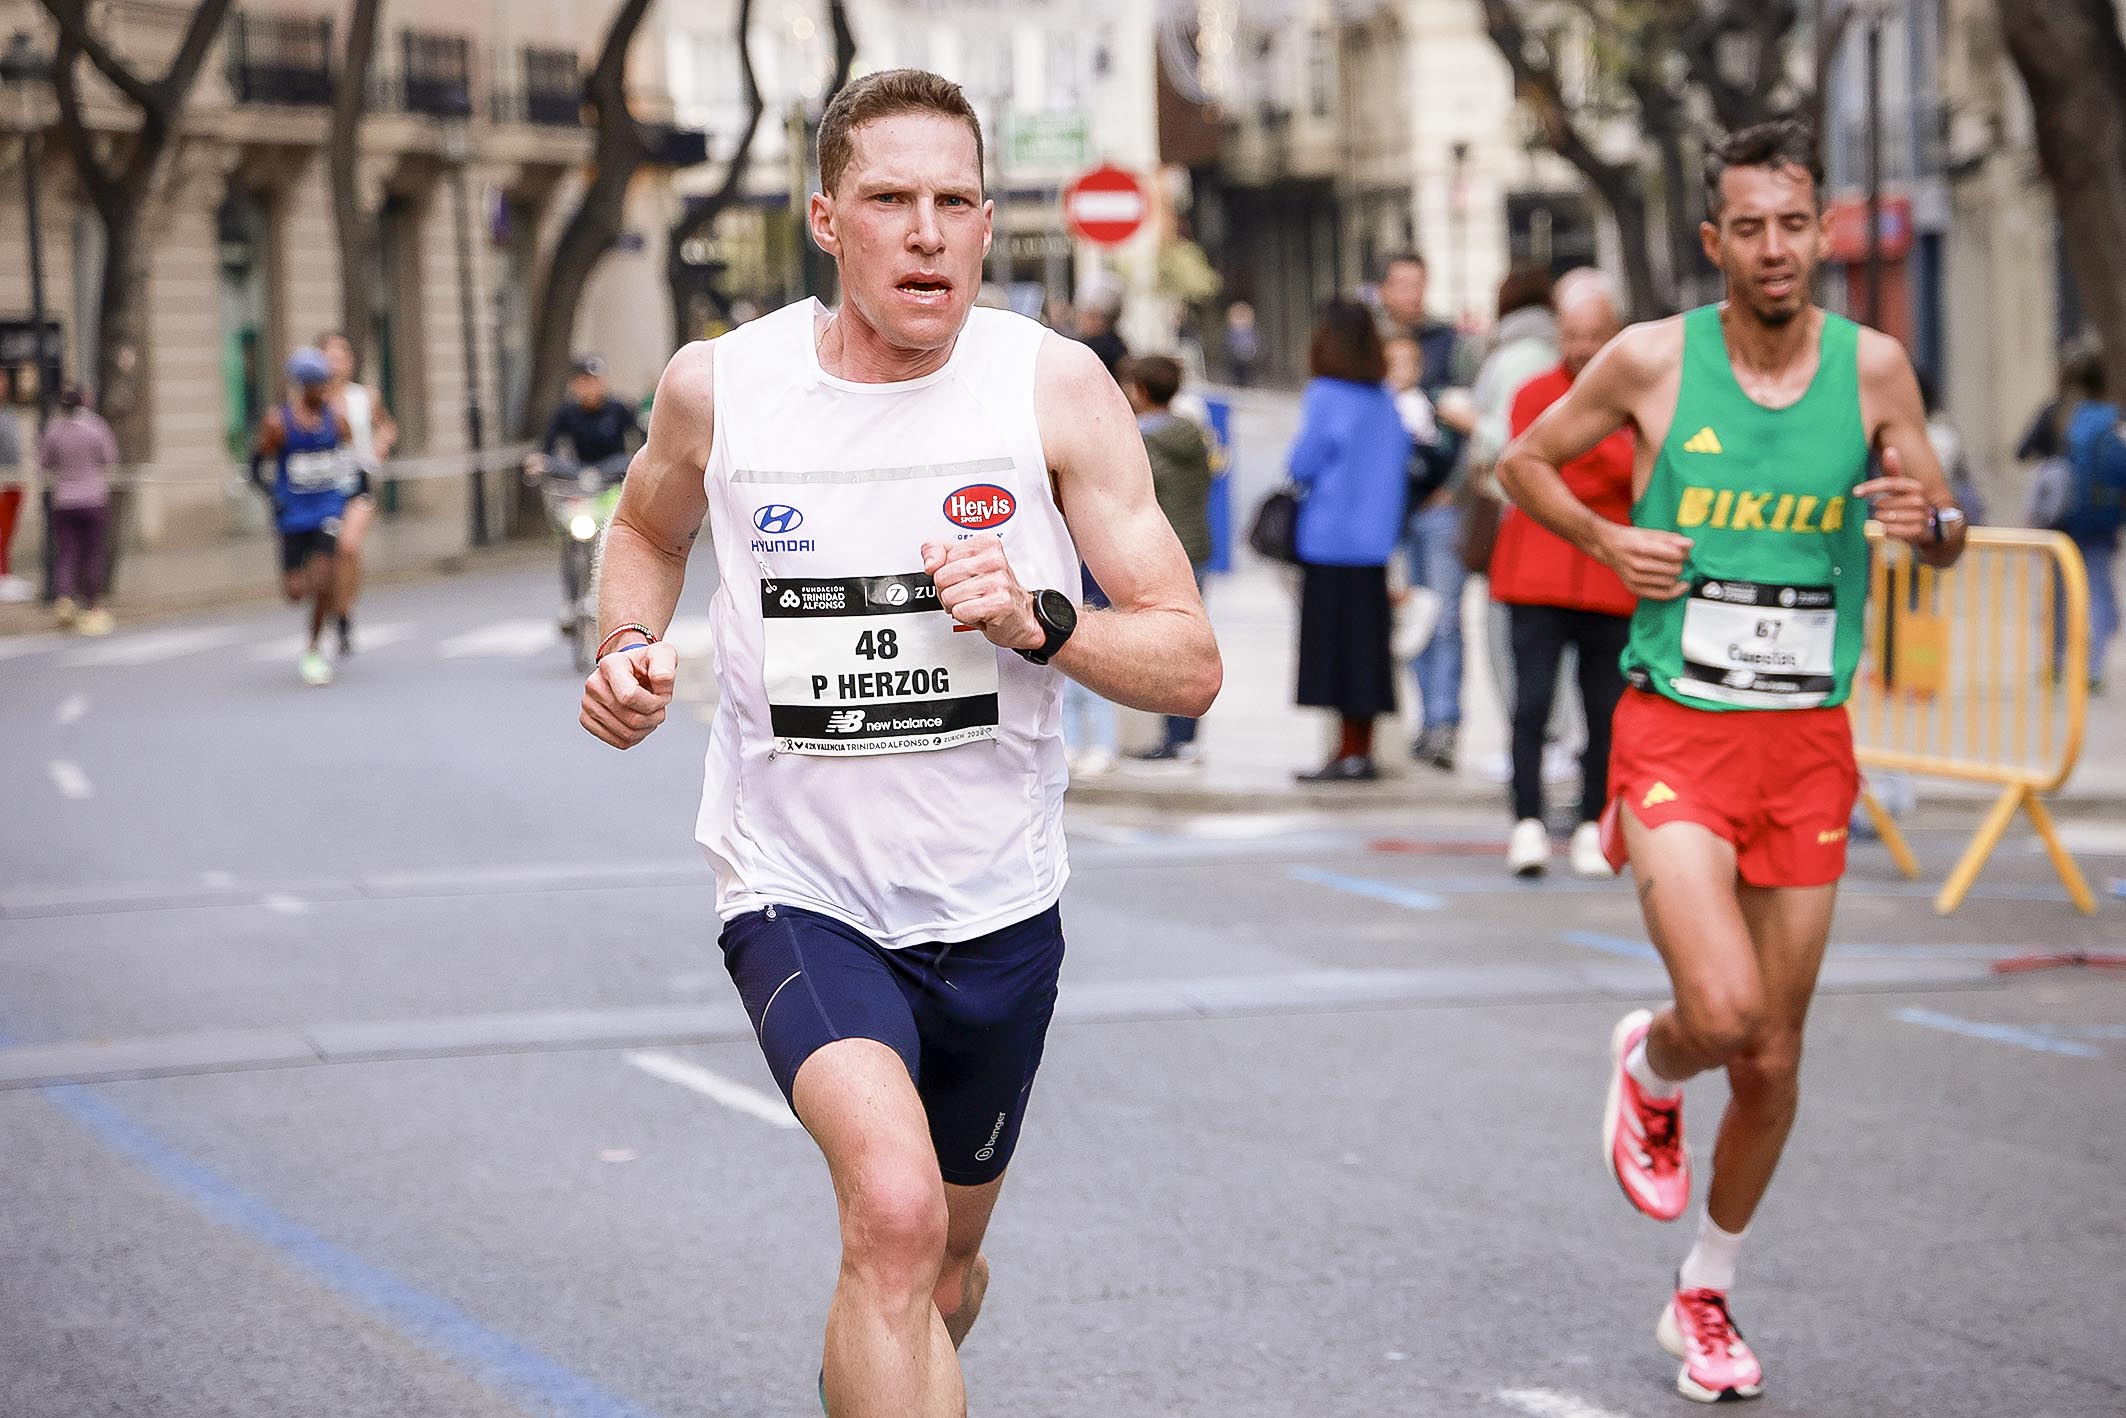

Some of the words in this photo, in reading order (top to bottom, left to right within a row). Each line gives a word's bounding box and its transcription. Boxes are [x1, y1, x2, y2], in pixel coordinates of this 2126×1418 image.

[950, 495, 1011, 520] Hervis
[960, 516, 983, 524] SPORTS
[751, 539, 815, 553] HYUNDAI
[801, 585, 845, 593] FUNDACIÓN
[801, 593, 846, 602] TRINIDAD
[802, 600, 846, 610] ALFONSO
[855, 628, 899, 660] 48
[811, 674, 828, 700] P
[838, 667, 950, 700] HERZOG
[866, 720, 891, 732] new
[893, 717, 943, 730] balance
[846, 741, 887, 752] TRINIDAD
[888, 738, 930, 749] ALFONSO
[984, 1111, 1006, 1147] benger
